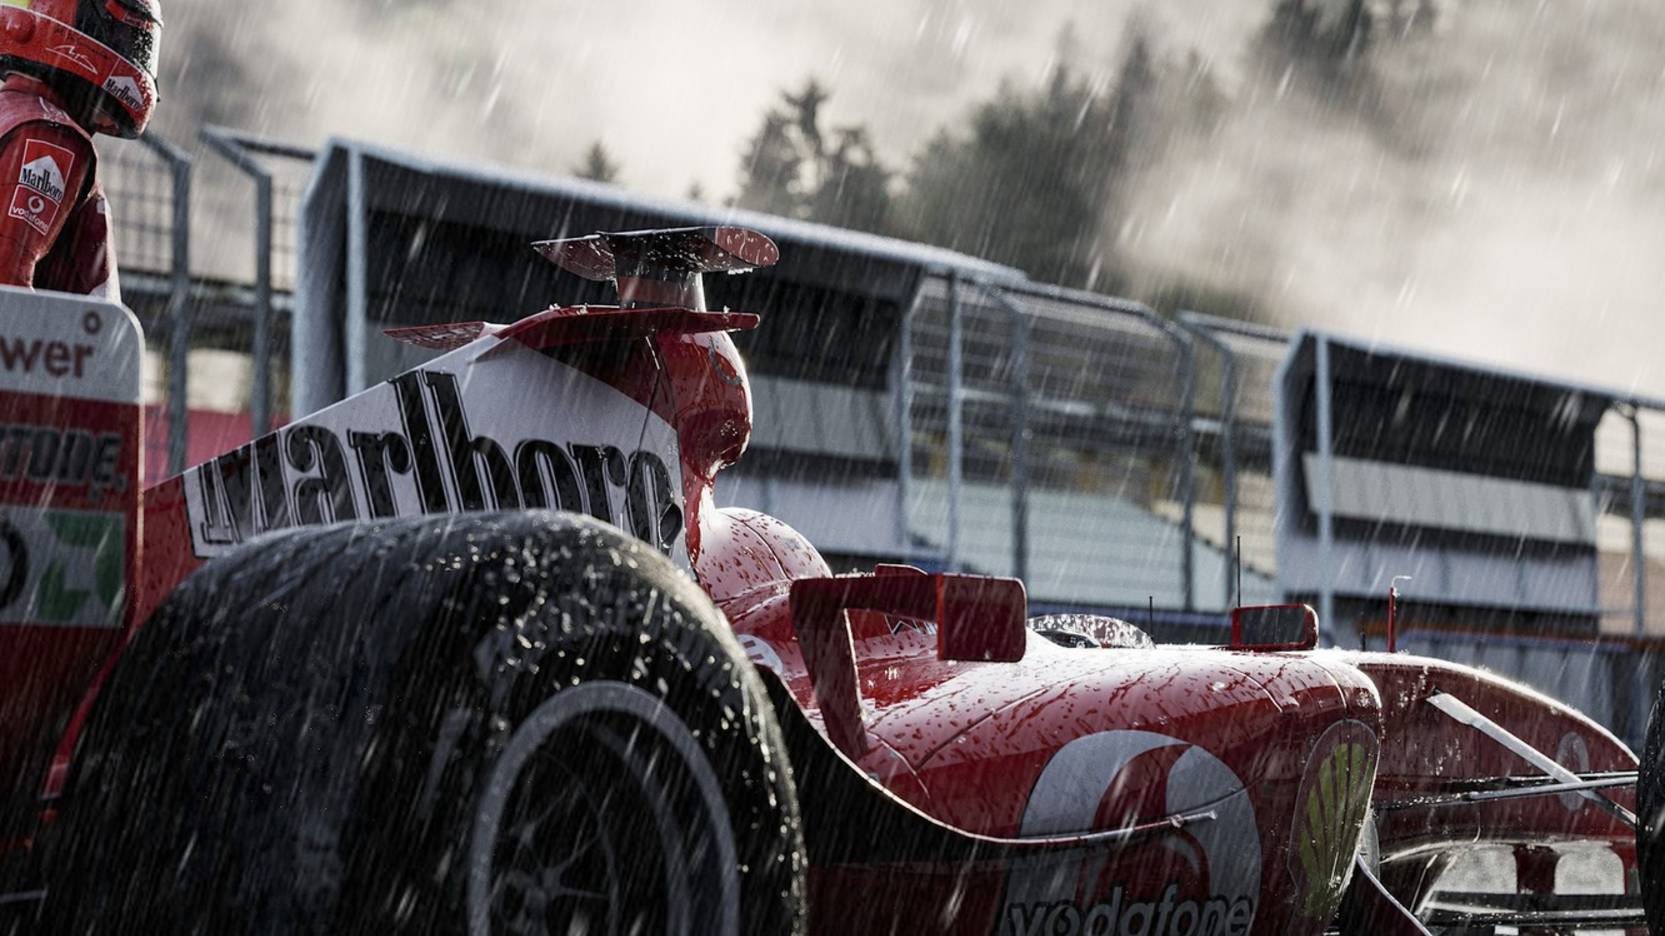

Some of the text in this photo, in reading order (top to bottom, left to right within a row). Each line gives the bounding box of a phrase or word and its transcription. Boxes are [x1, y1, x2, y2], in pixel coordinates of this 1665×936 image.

[105, 77, 142, 111] Marlboro
[20, 168, 64, 202] Marlboro
[12, 205, 49, 232] vodafone
[201, 370, 677, 547] Marlboro
[1007, 882, 1254, 936] vodafone
